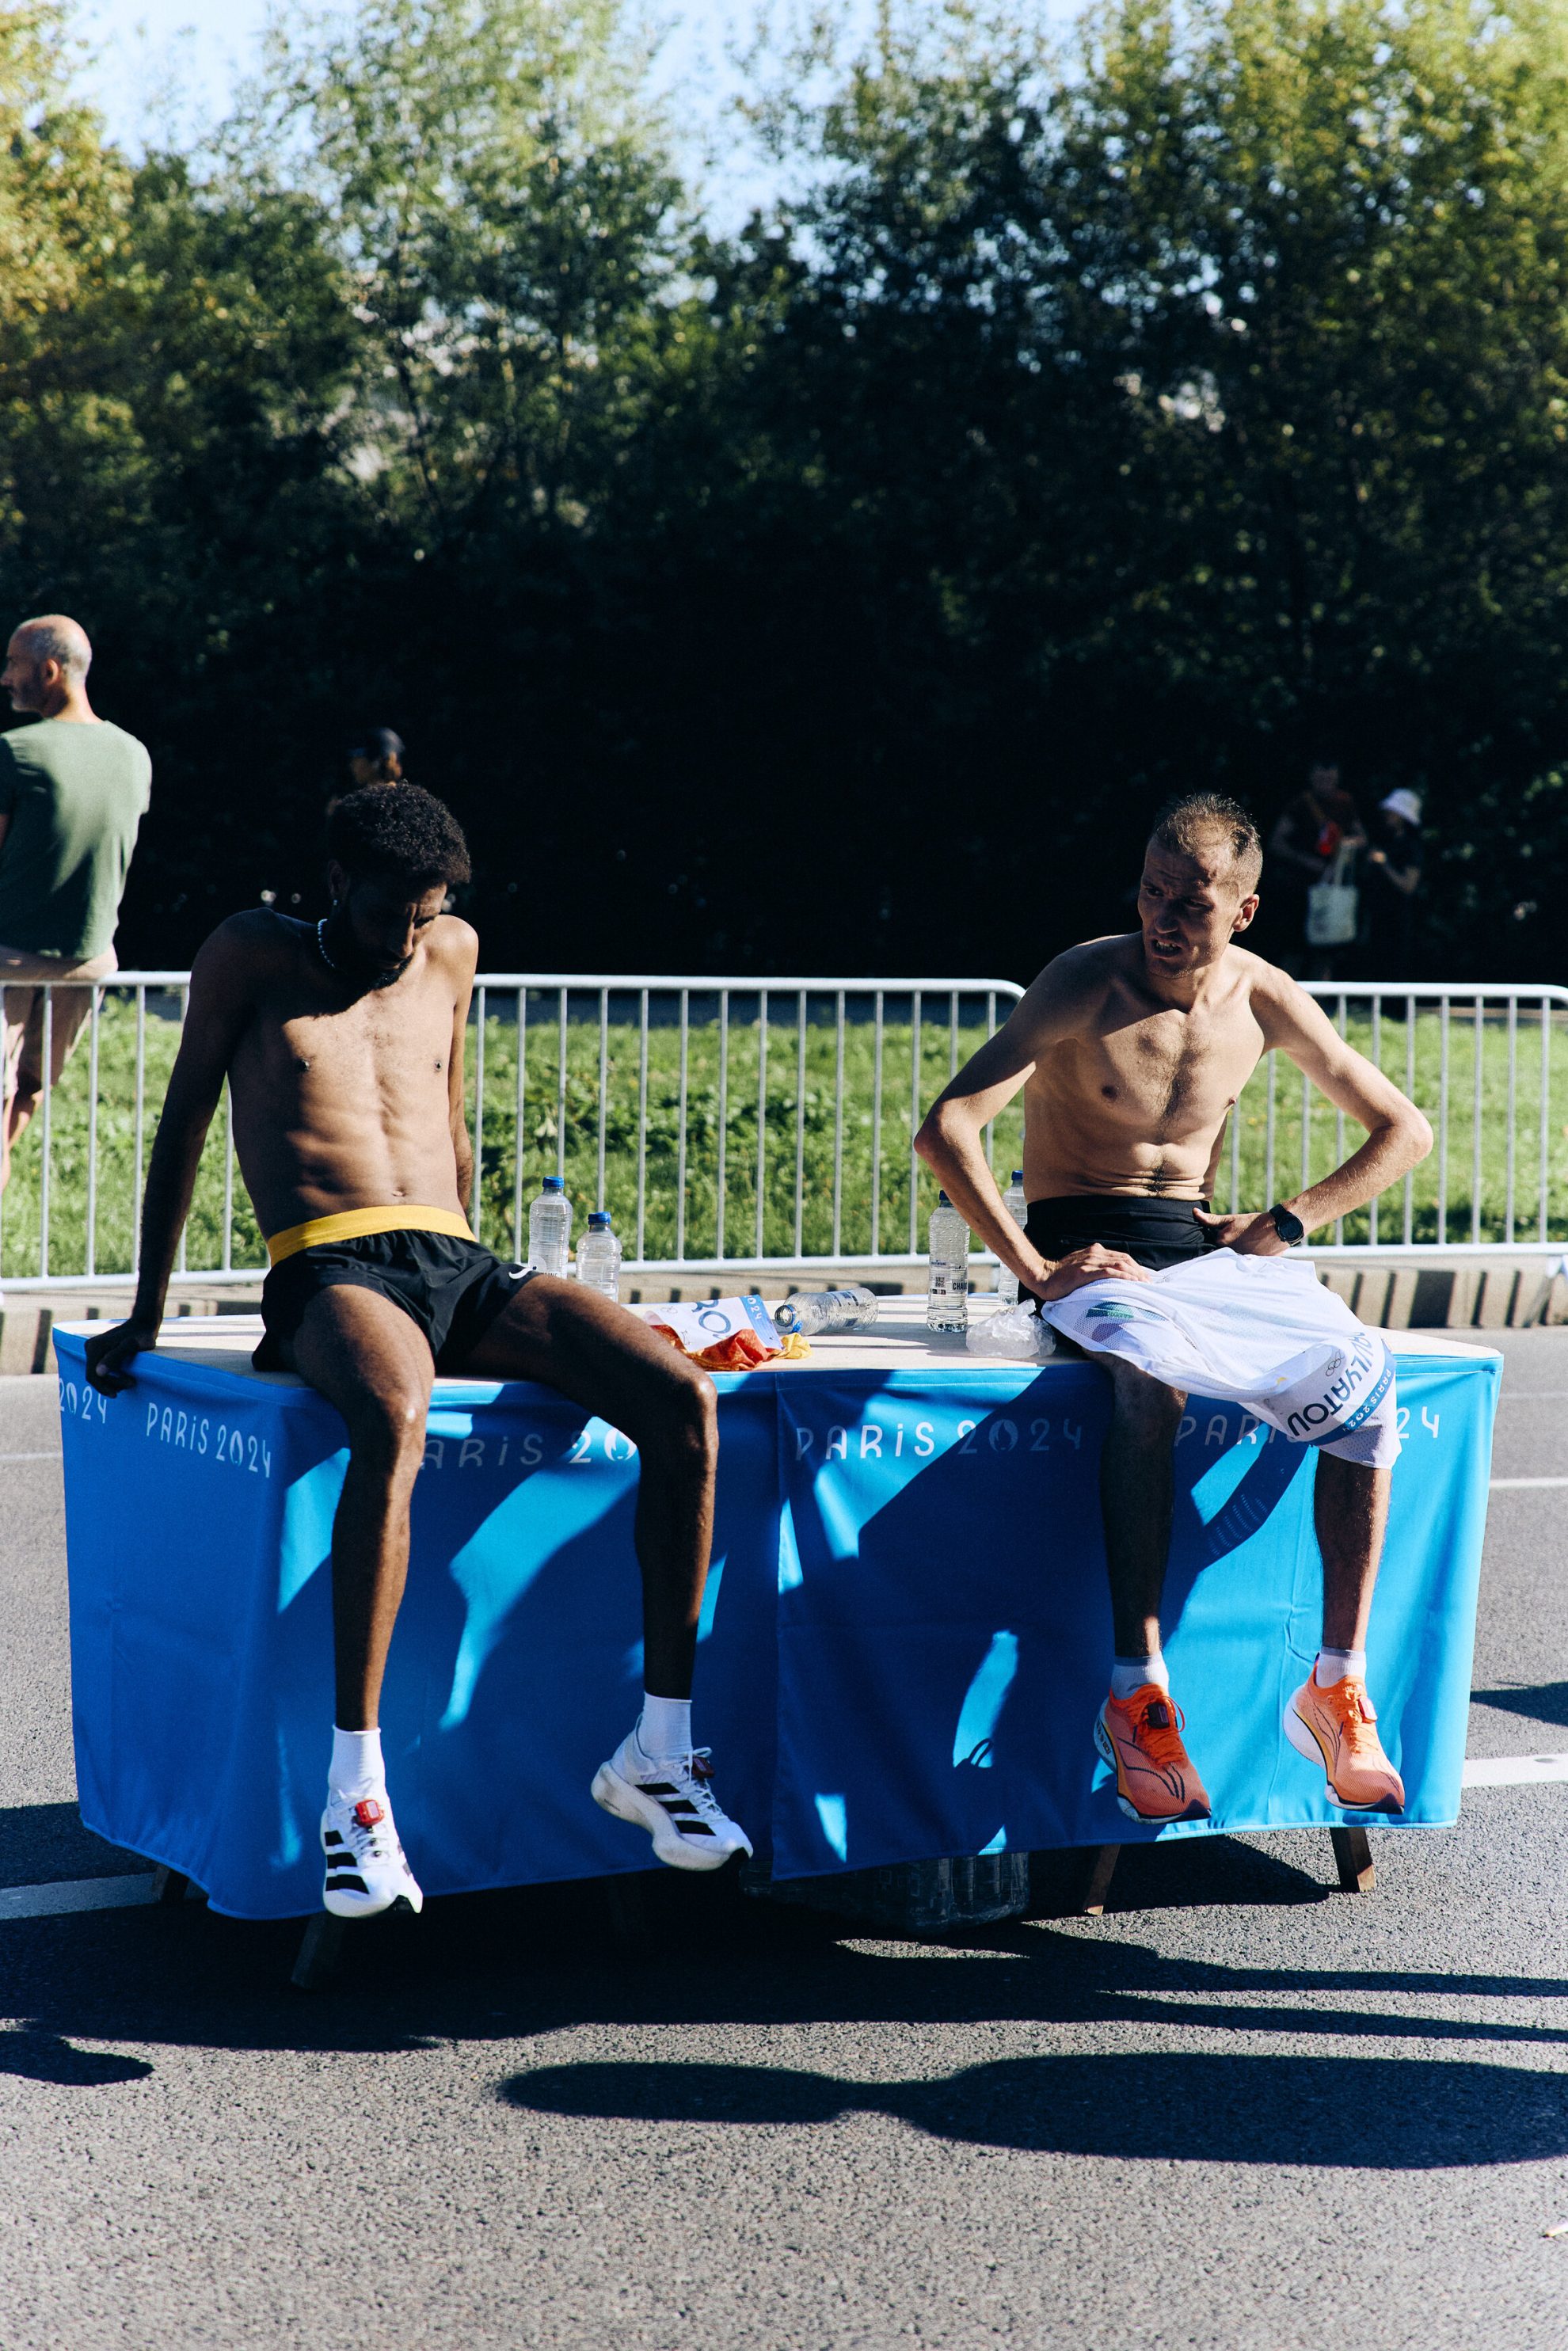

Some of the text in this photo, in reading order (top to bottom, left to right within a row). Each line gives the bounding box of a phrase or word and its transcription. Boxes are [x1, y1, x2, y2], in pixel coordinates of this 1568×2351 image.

[1371, 1368, 1392, 1405] PARIS
[215, 1425, 272, 1478] 2024
[957, 1418, 1082, 1455] 2024
